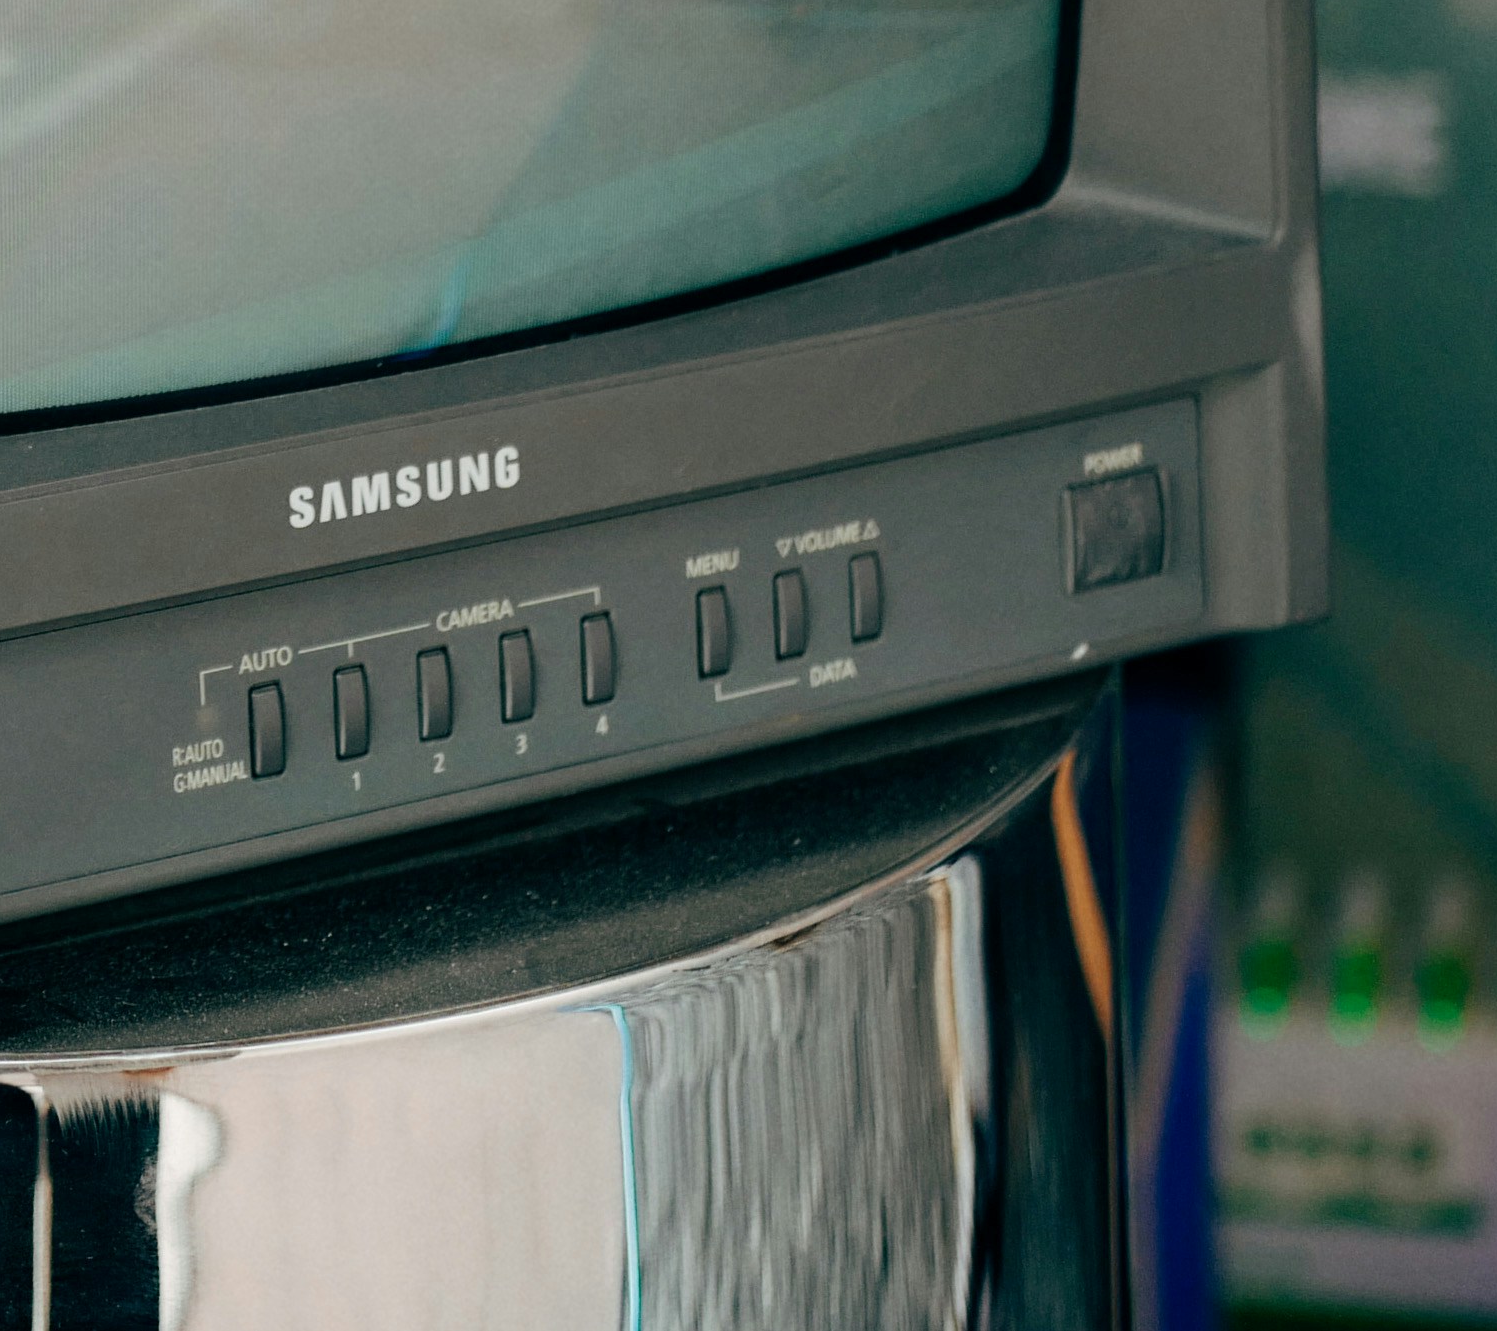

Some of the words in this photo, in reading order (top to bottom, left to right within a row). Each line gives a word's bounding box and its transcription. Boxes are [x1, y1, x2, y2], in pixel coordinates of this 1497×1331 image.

[1082, 442, 1144, 476] POWER
[288, 445, 522, 530] SAMSUNG
[794, 519, 861, 556] VOLUME
[684, 547, 741, 579] MENU
[435, 598, 515, 633] CAMERA
[237, 645, 294, 675] AUTO
[808, 657, 858, 688] DATA
[351, 771, 362, 792] 1
[432, 752, 446, 774] 2
[515, 732, 529, 756] 3
[595, 714, 610, 737] 4
